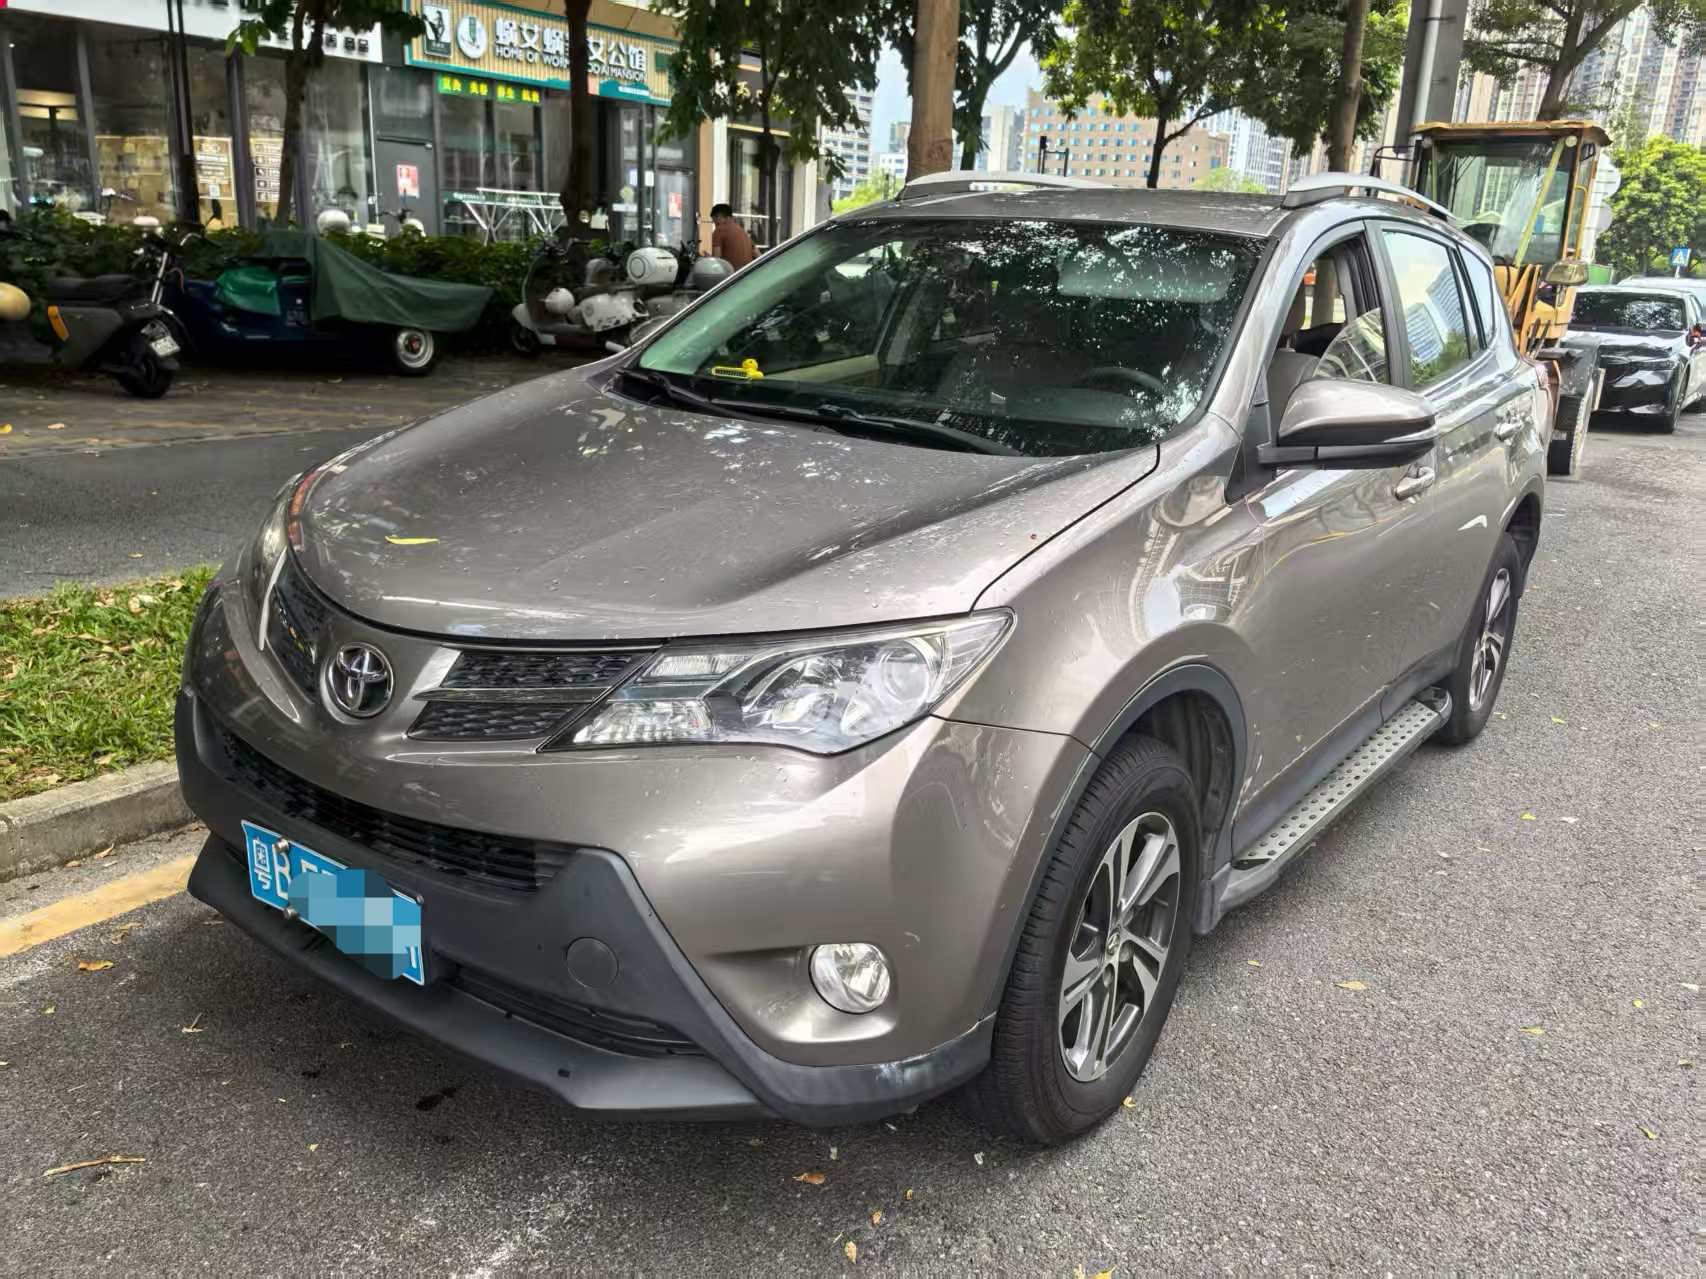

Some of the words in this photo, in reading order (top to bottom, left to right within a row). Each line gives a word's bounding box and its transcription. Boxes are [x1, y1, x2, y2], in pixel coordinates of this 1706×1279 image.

[495, 46, 522, 61] HOME
[526, 50, 540, 64] OF
[609, 65, 647, 82] MANSION
